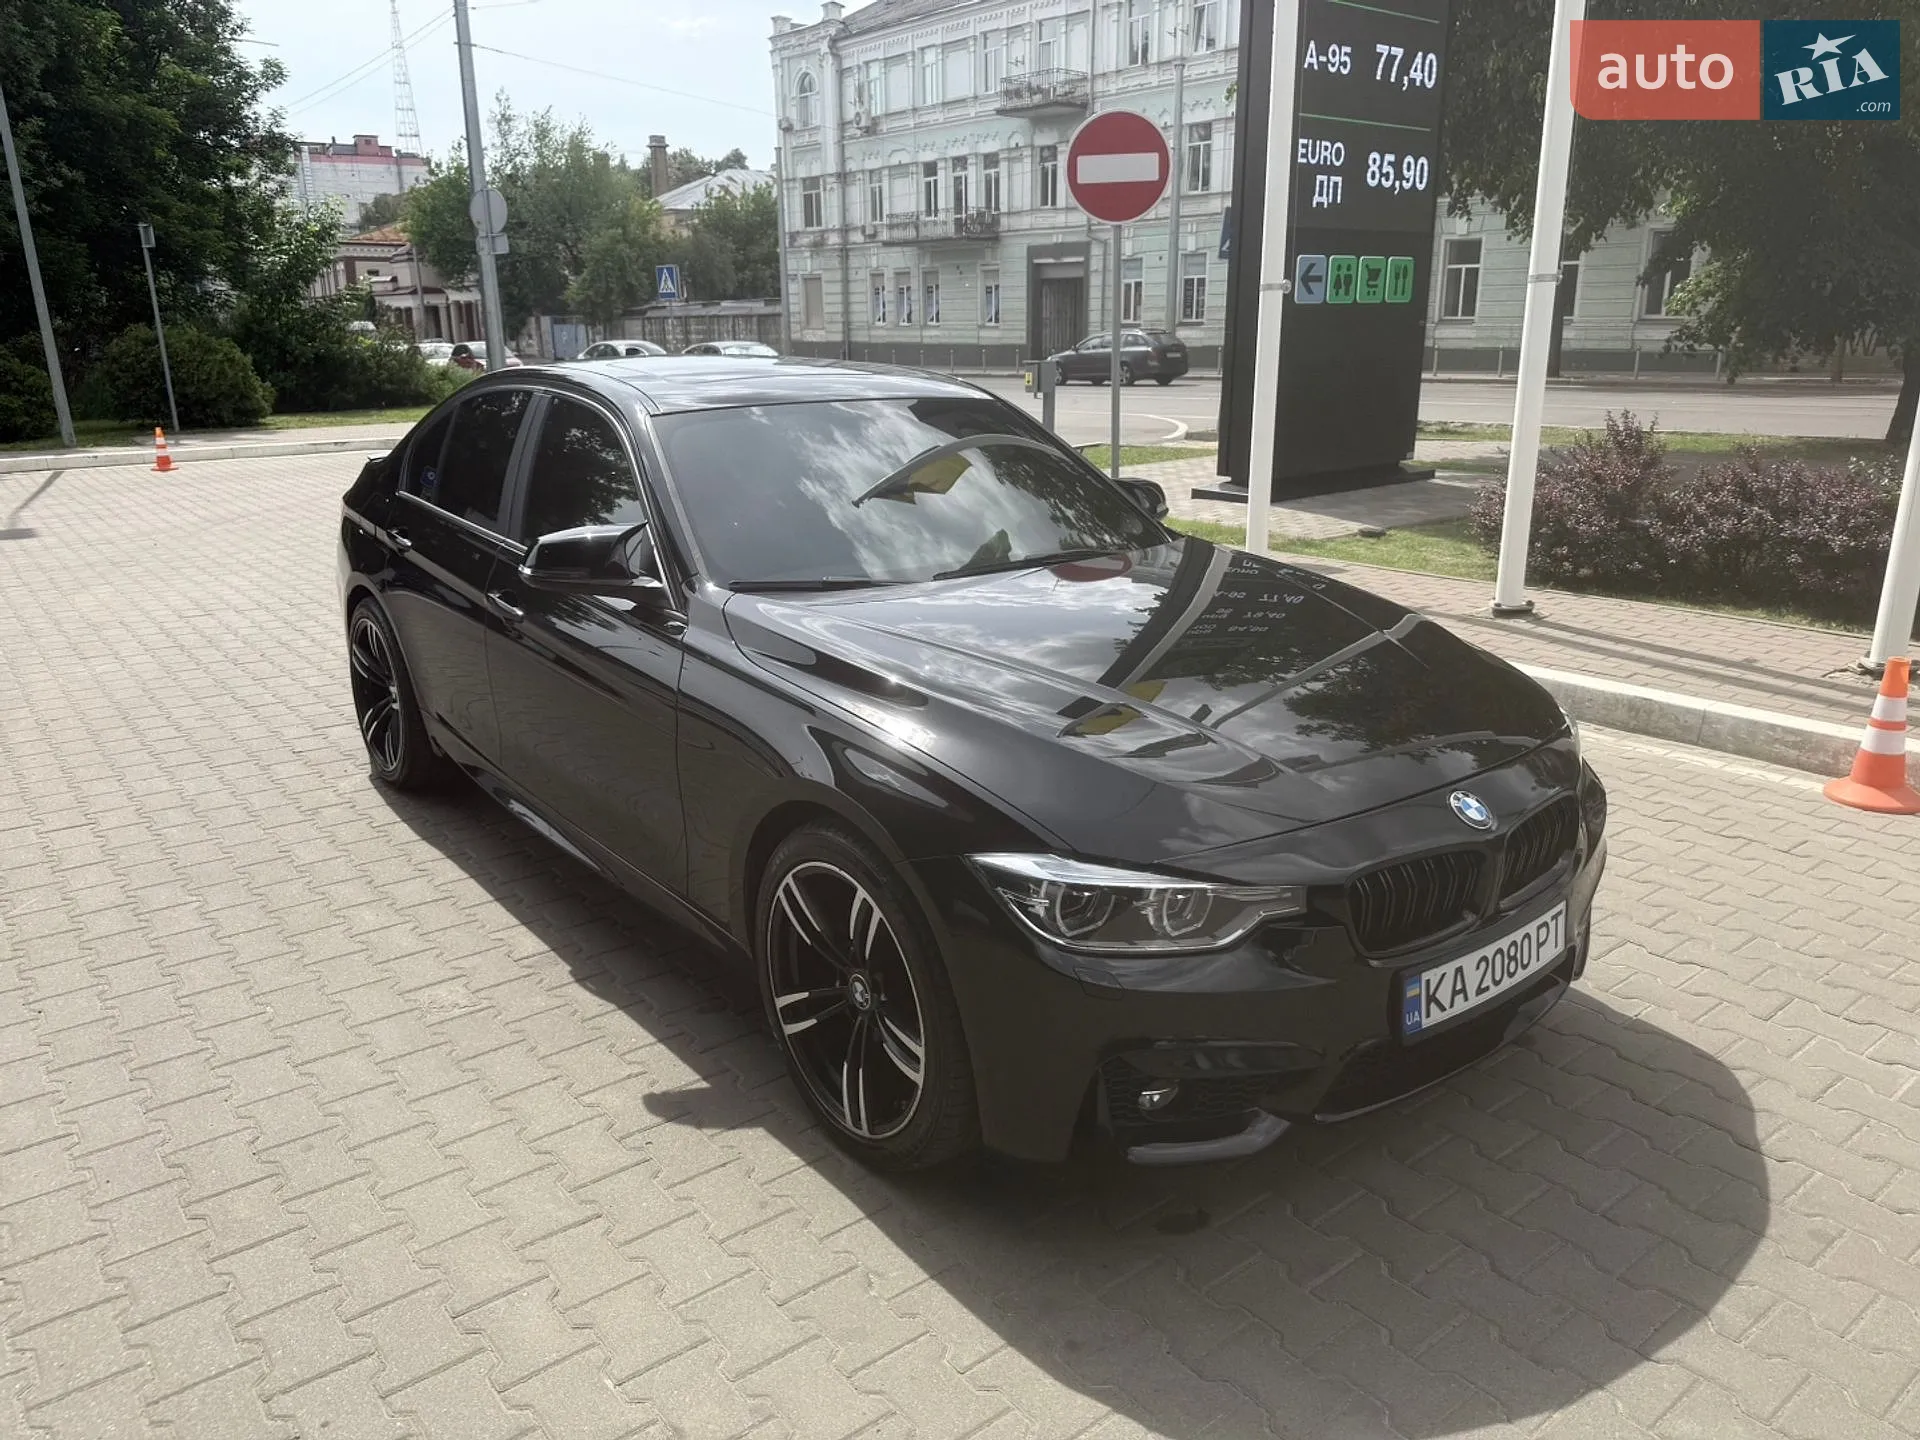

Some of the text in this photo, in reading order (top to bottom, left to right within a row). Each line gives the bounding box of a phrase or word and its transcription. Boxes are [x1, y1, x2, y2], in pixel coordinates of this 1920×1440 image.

[1304, 40, 1437, 91] A-95 77,40
[1298, 138, 1428, 194] EURO 85,90
[1312, 174, 1343, 208] ДП
[1424, 908, 1563, 1019] KA 2080 PT
[1405, 1010, 1420, 1026] UA
